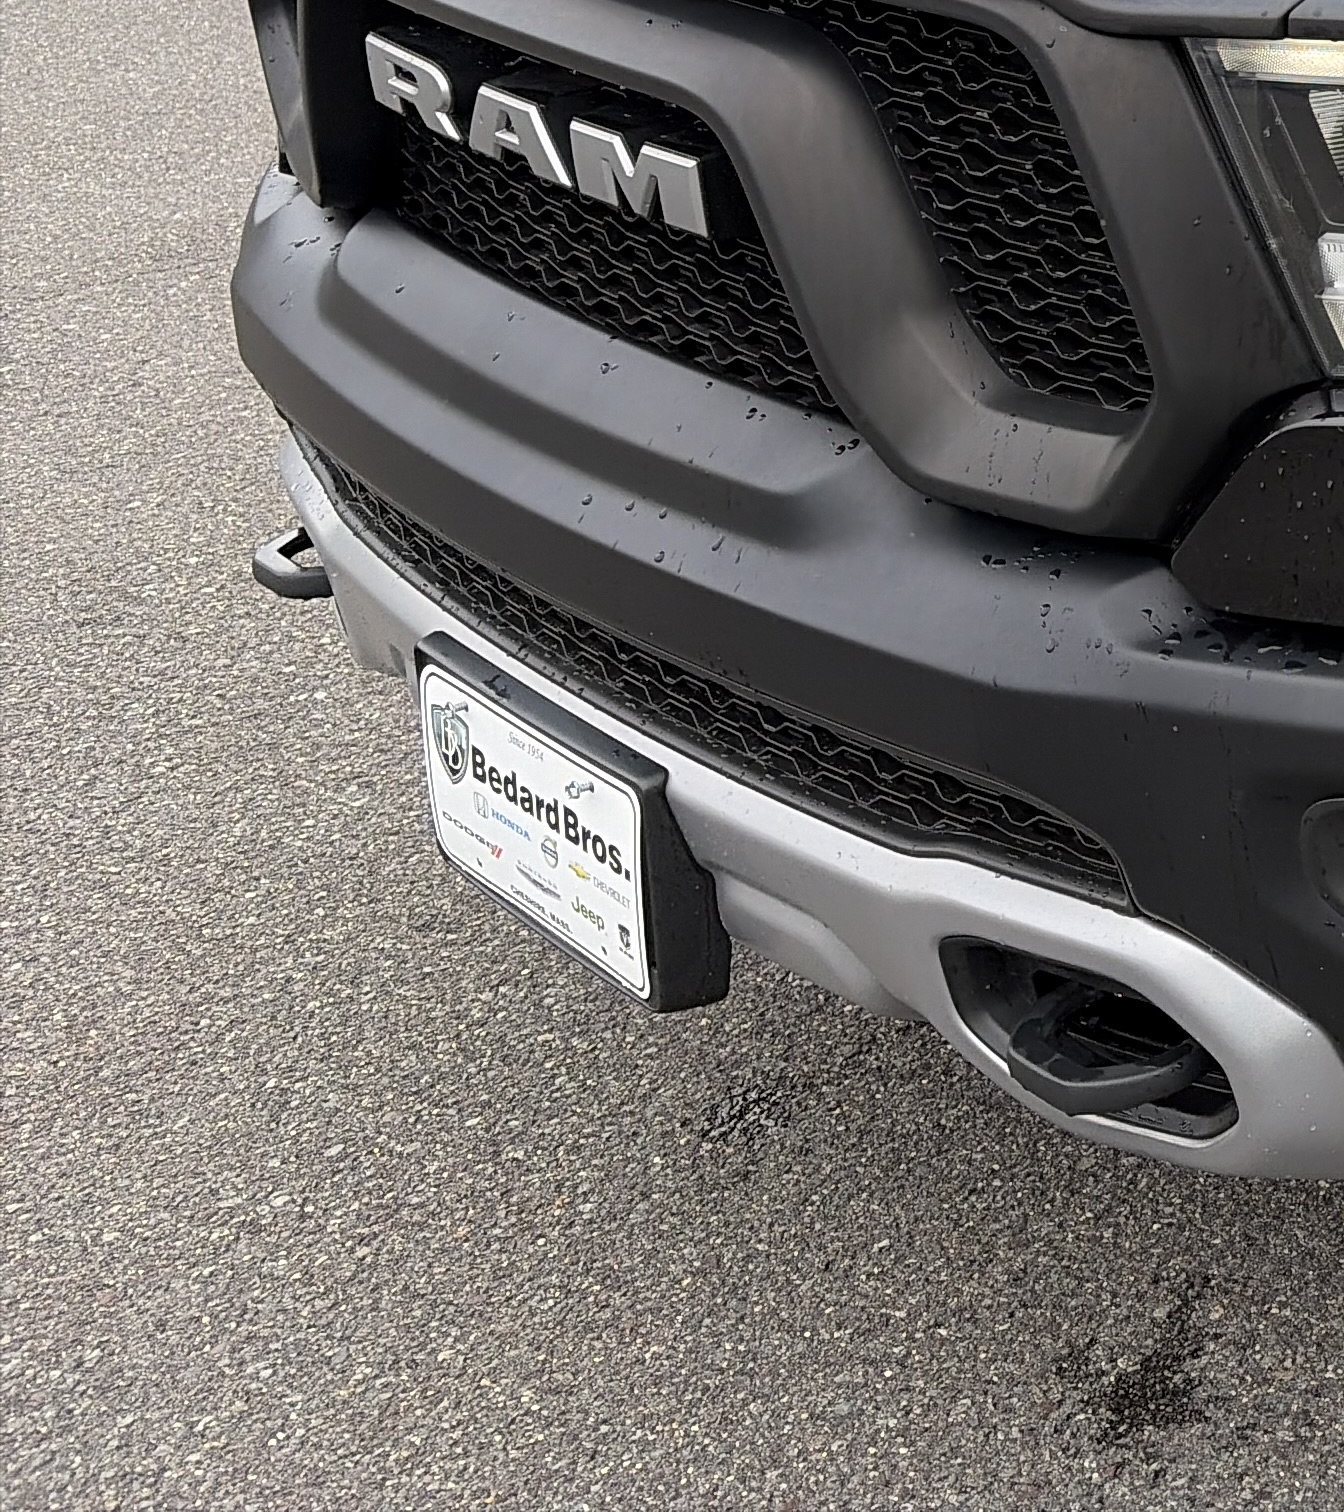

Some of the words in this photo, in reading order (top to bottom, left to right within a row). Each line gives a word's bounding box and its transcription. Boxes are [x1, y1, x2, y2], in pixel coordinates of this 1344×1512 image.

[365, 31, 709, 238] RAM
[507, 731, 526, 750] Since
[527, 744, 545, 763] 1954
[491, 807, 532, 842] HONDA
[593, 876, 631, 909] CHEVROLET
[571, 895, 605, 932] Jeep
